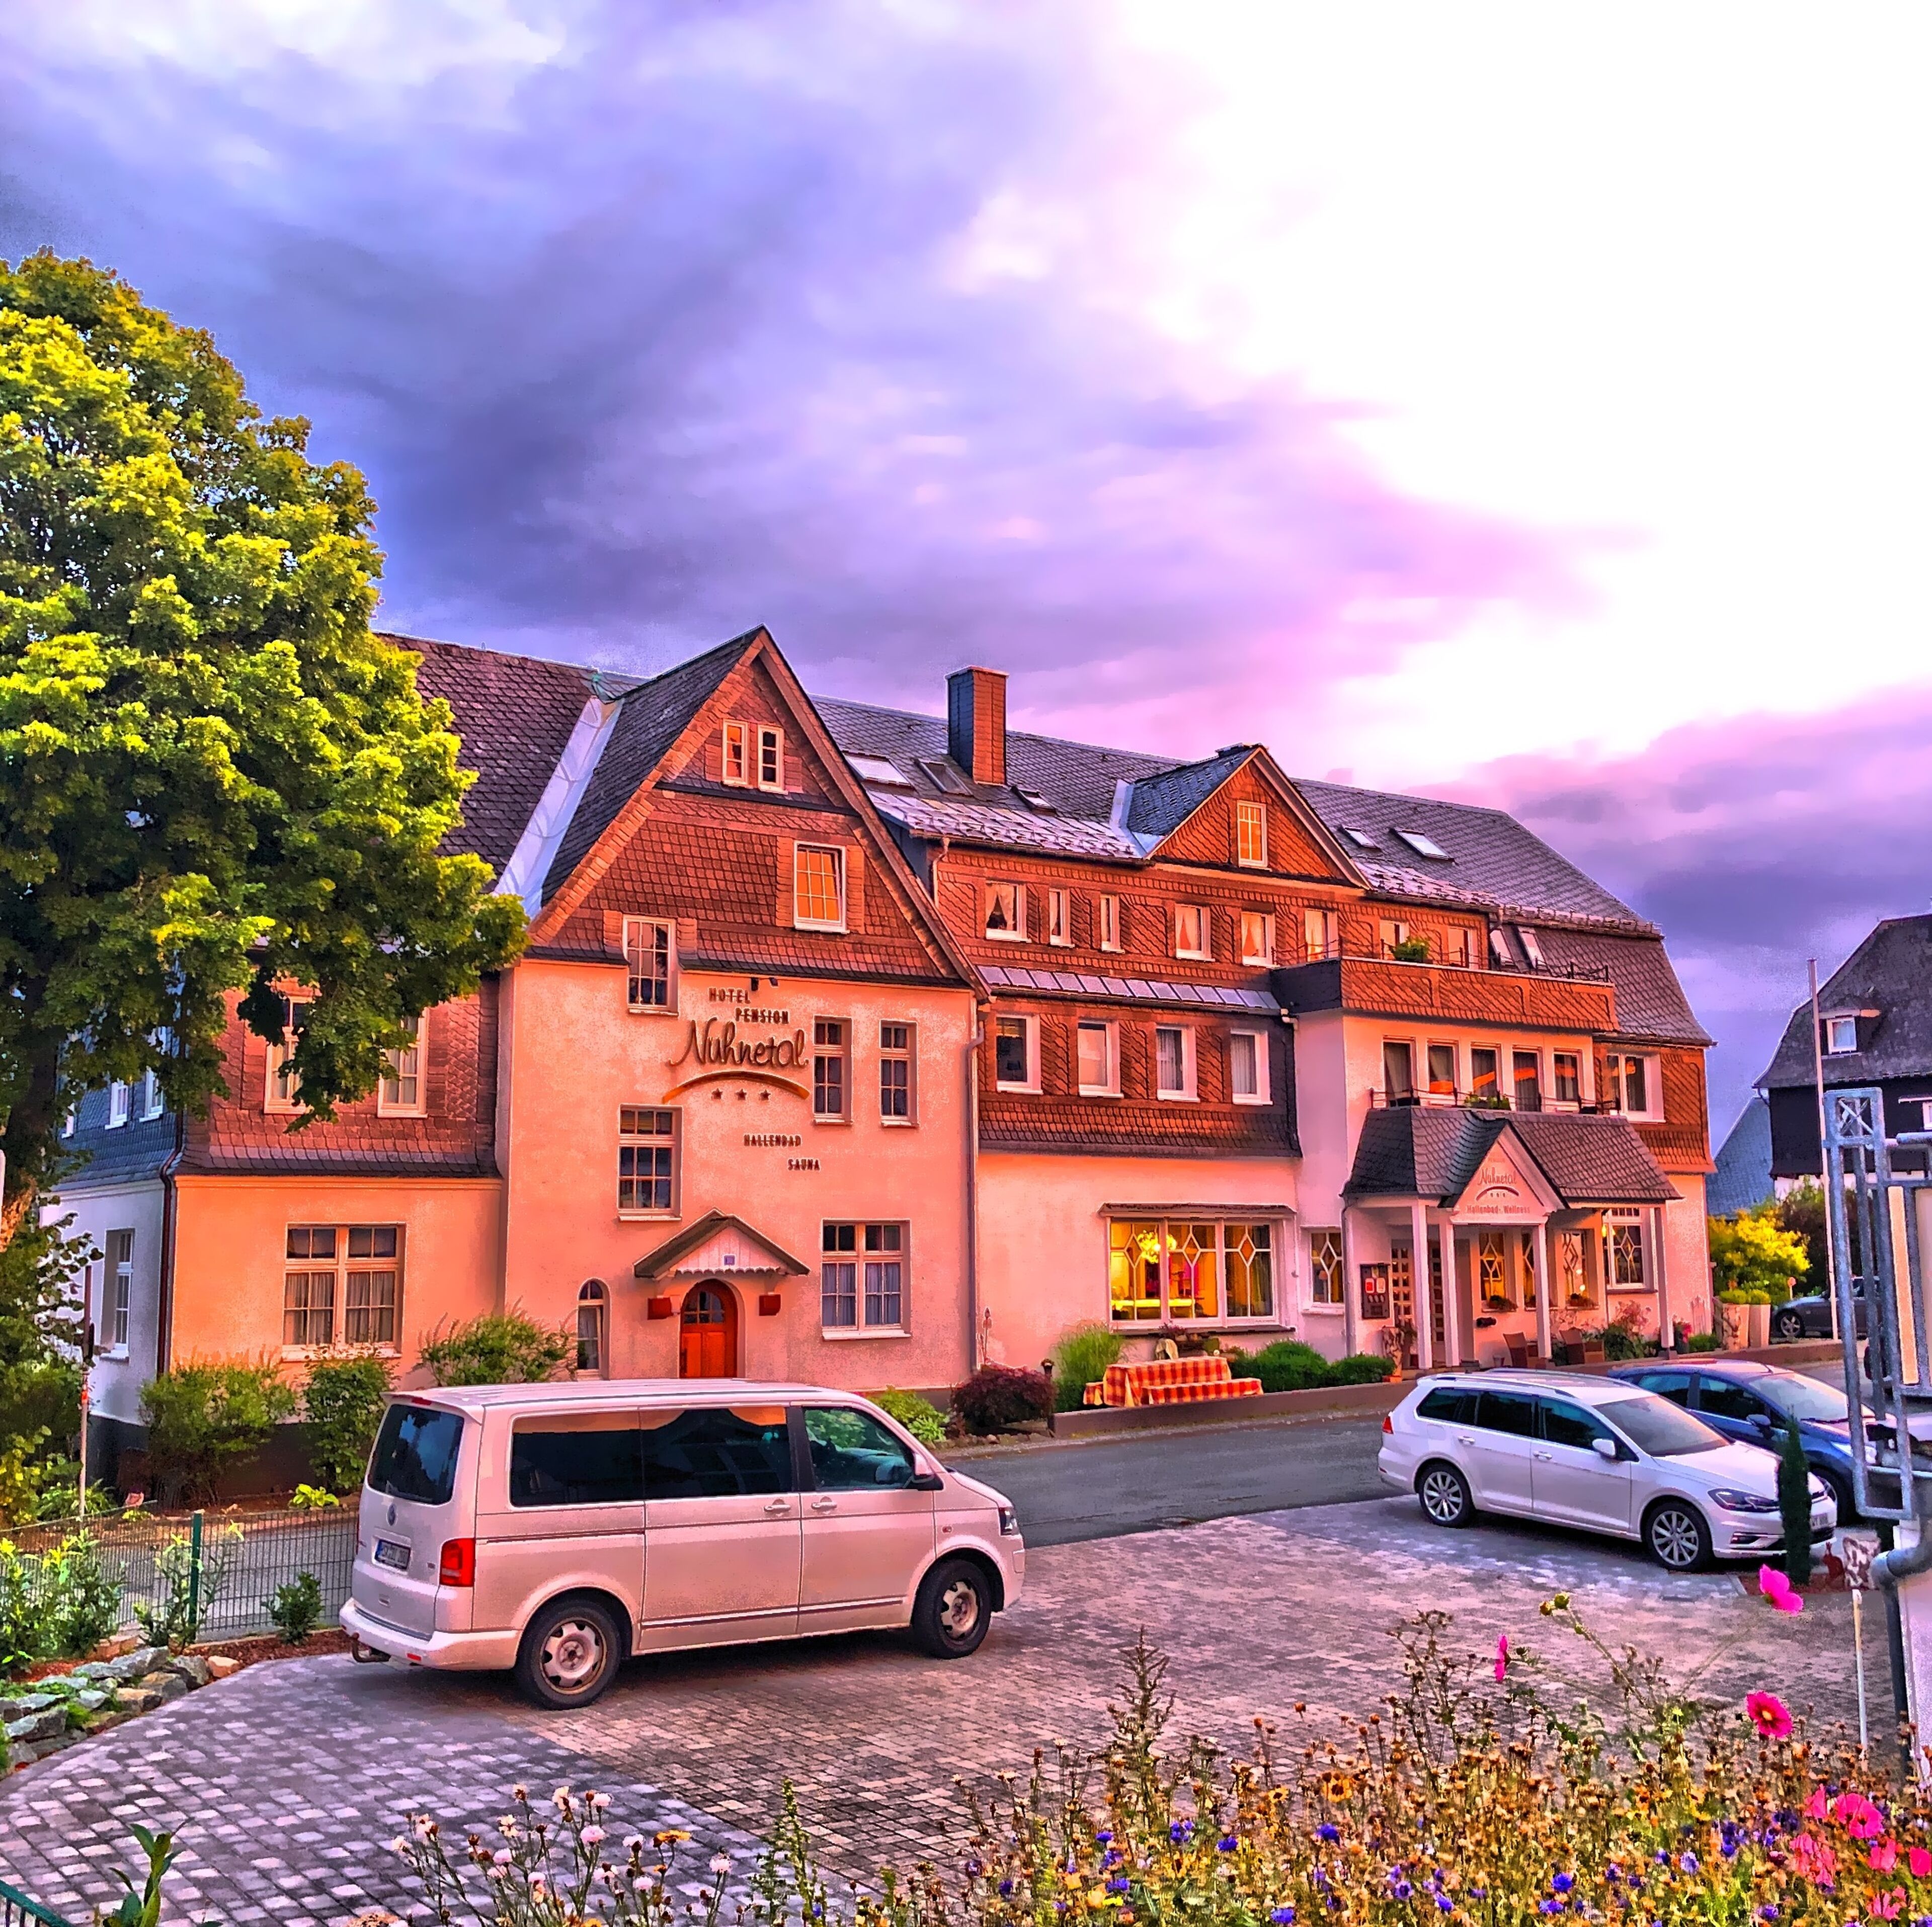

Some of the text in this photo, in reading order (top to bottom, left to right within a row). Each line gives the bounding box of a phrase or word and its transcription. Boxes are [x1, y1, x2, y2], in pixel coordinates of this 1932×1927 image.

[709, 987, 751, 1004] HOTEL
[736, 1008, 789, 1024] PENSION
[669, 1017, 809, 1067] Nuhnetal
[744, 1134, 801, 1147] HALLENBAD
[788, 1159, 820, 1171] SAUNA
